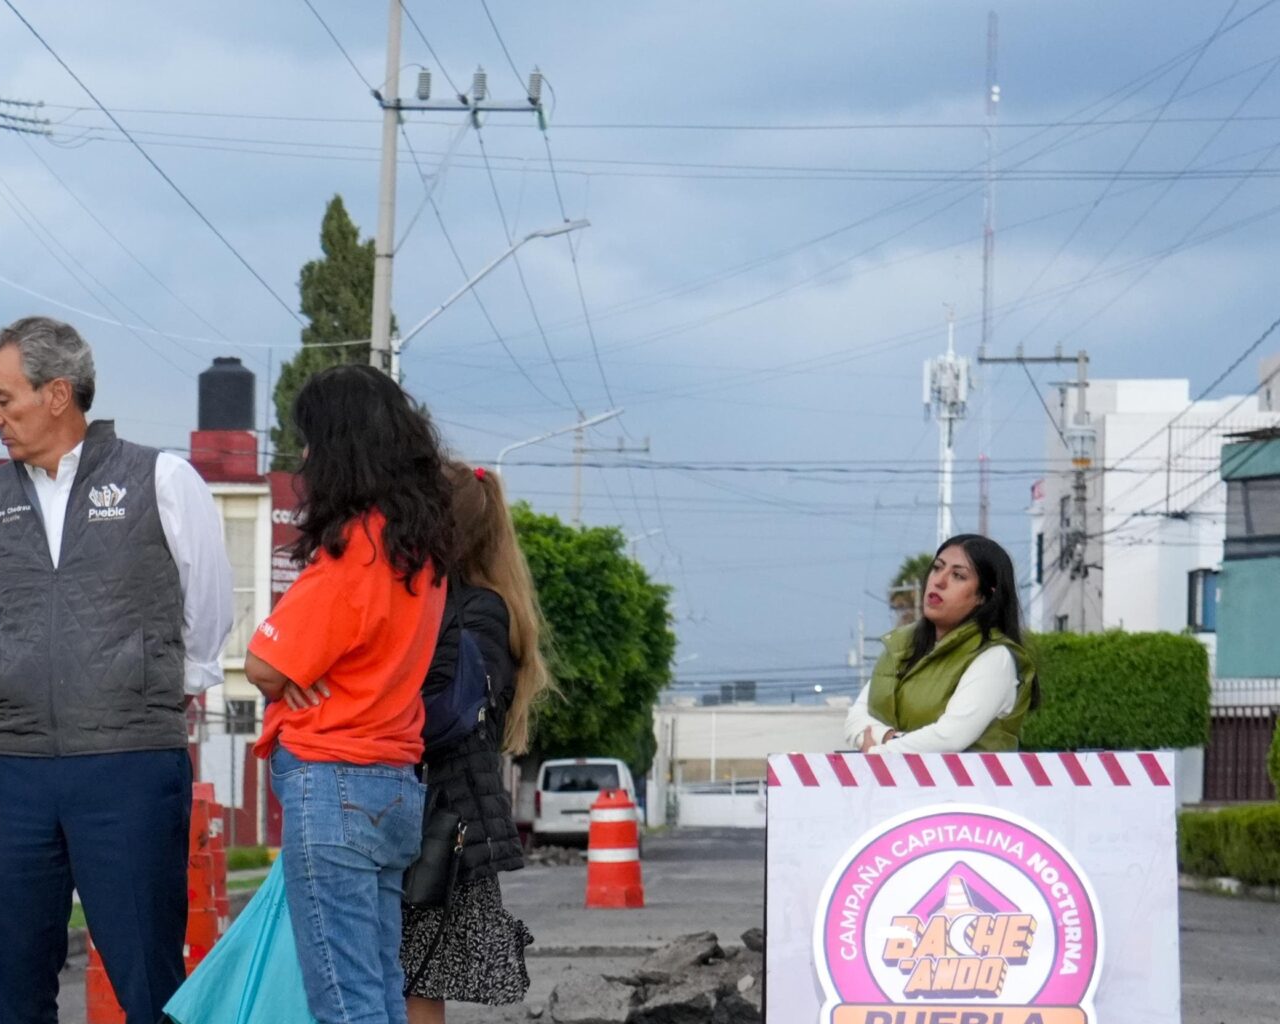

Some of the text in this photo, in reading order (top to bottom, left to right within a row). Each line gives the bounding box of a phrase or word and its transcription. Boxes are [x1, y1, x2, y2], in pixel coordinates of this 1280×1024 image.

[88, 507, 125, 519] Puebla
[840, 824, 1082, 976] CAMPAÑA CAPITALINA NOCTURNA
